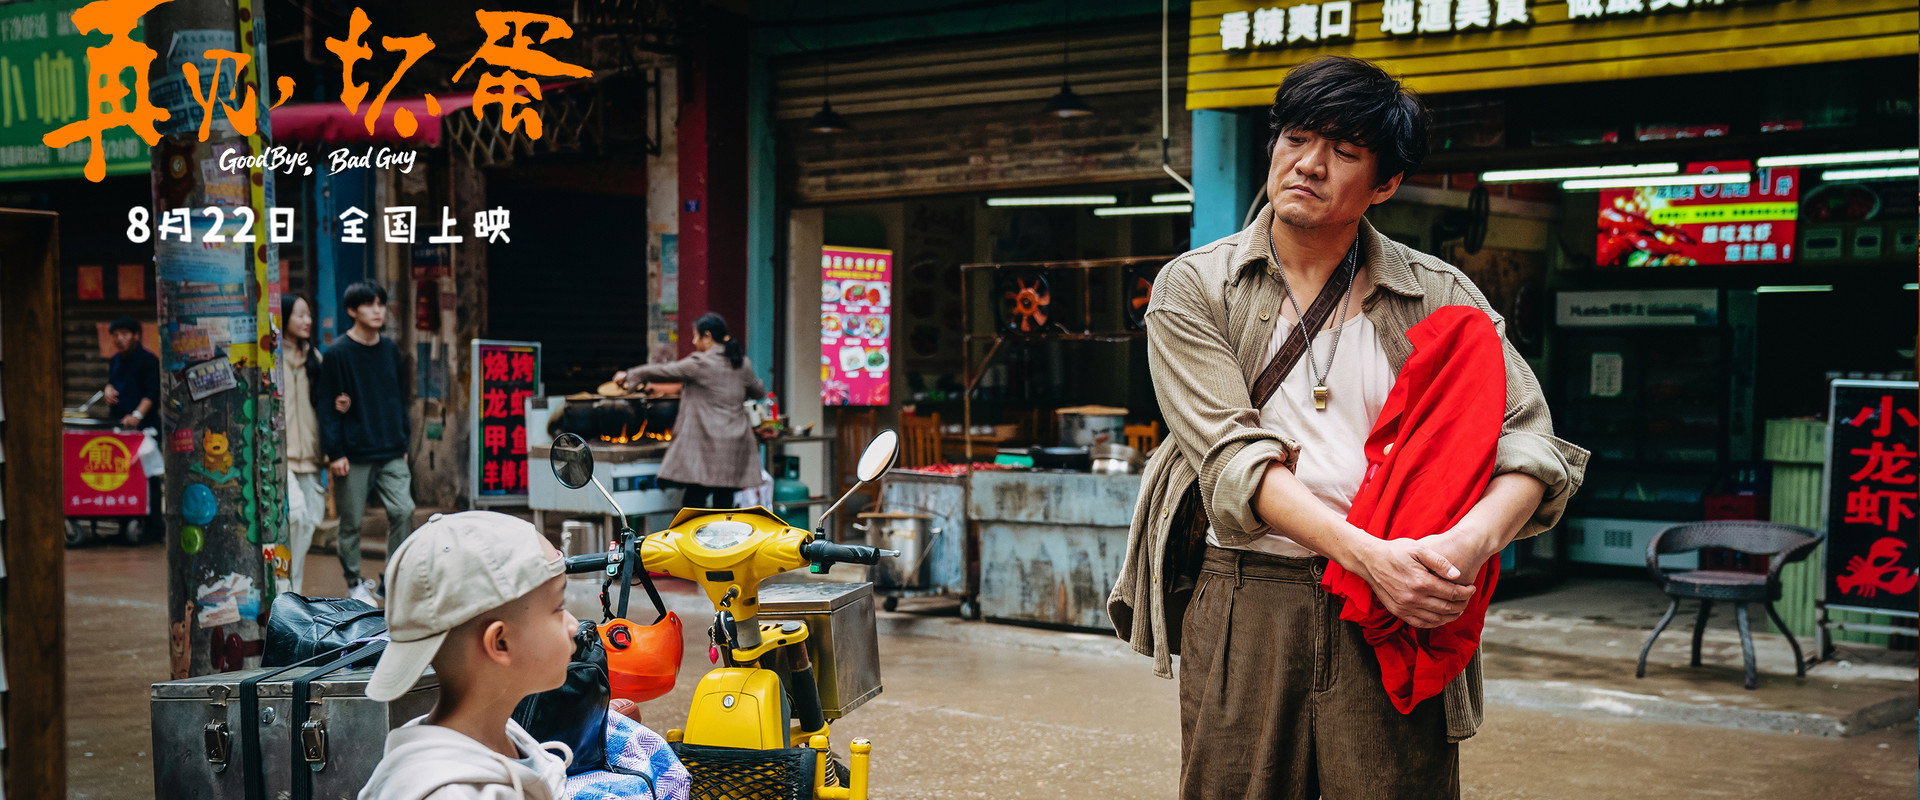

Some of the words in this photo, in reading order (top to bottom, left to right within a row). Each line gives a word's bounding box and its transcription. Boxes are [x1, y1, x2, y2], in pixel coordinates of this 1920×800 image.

[1219, 2, 1351, 50] 香辣爽口
[1380, 0, 1529, 34] 地道美食
[483, 351, 535, 383] 烧烤
[484, 425, 528, 456] 甲鱼
[1844, 395, 1919, 532] 小龙虾
